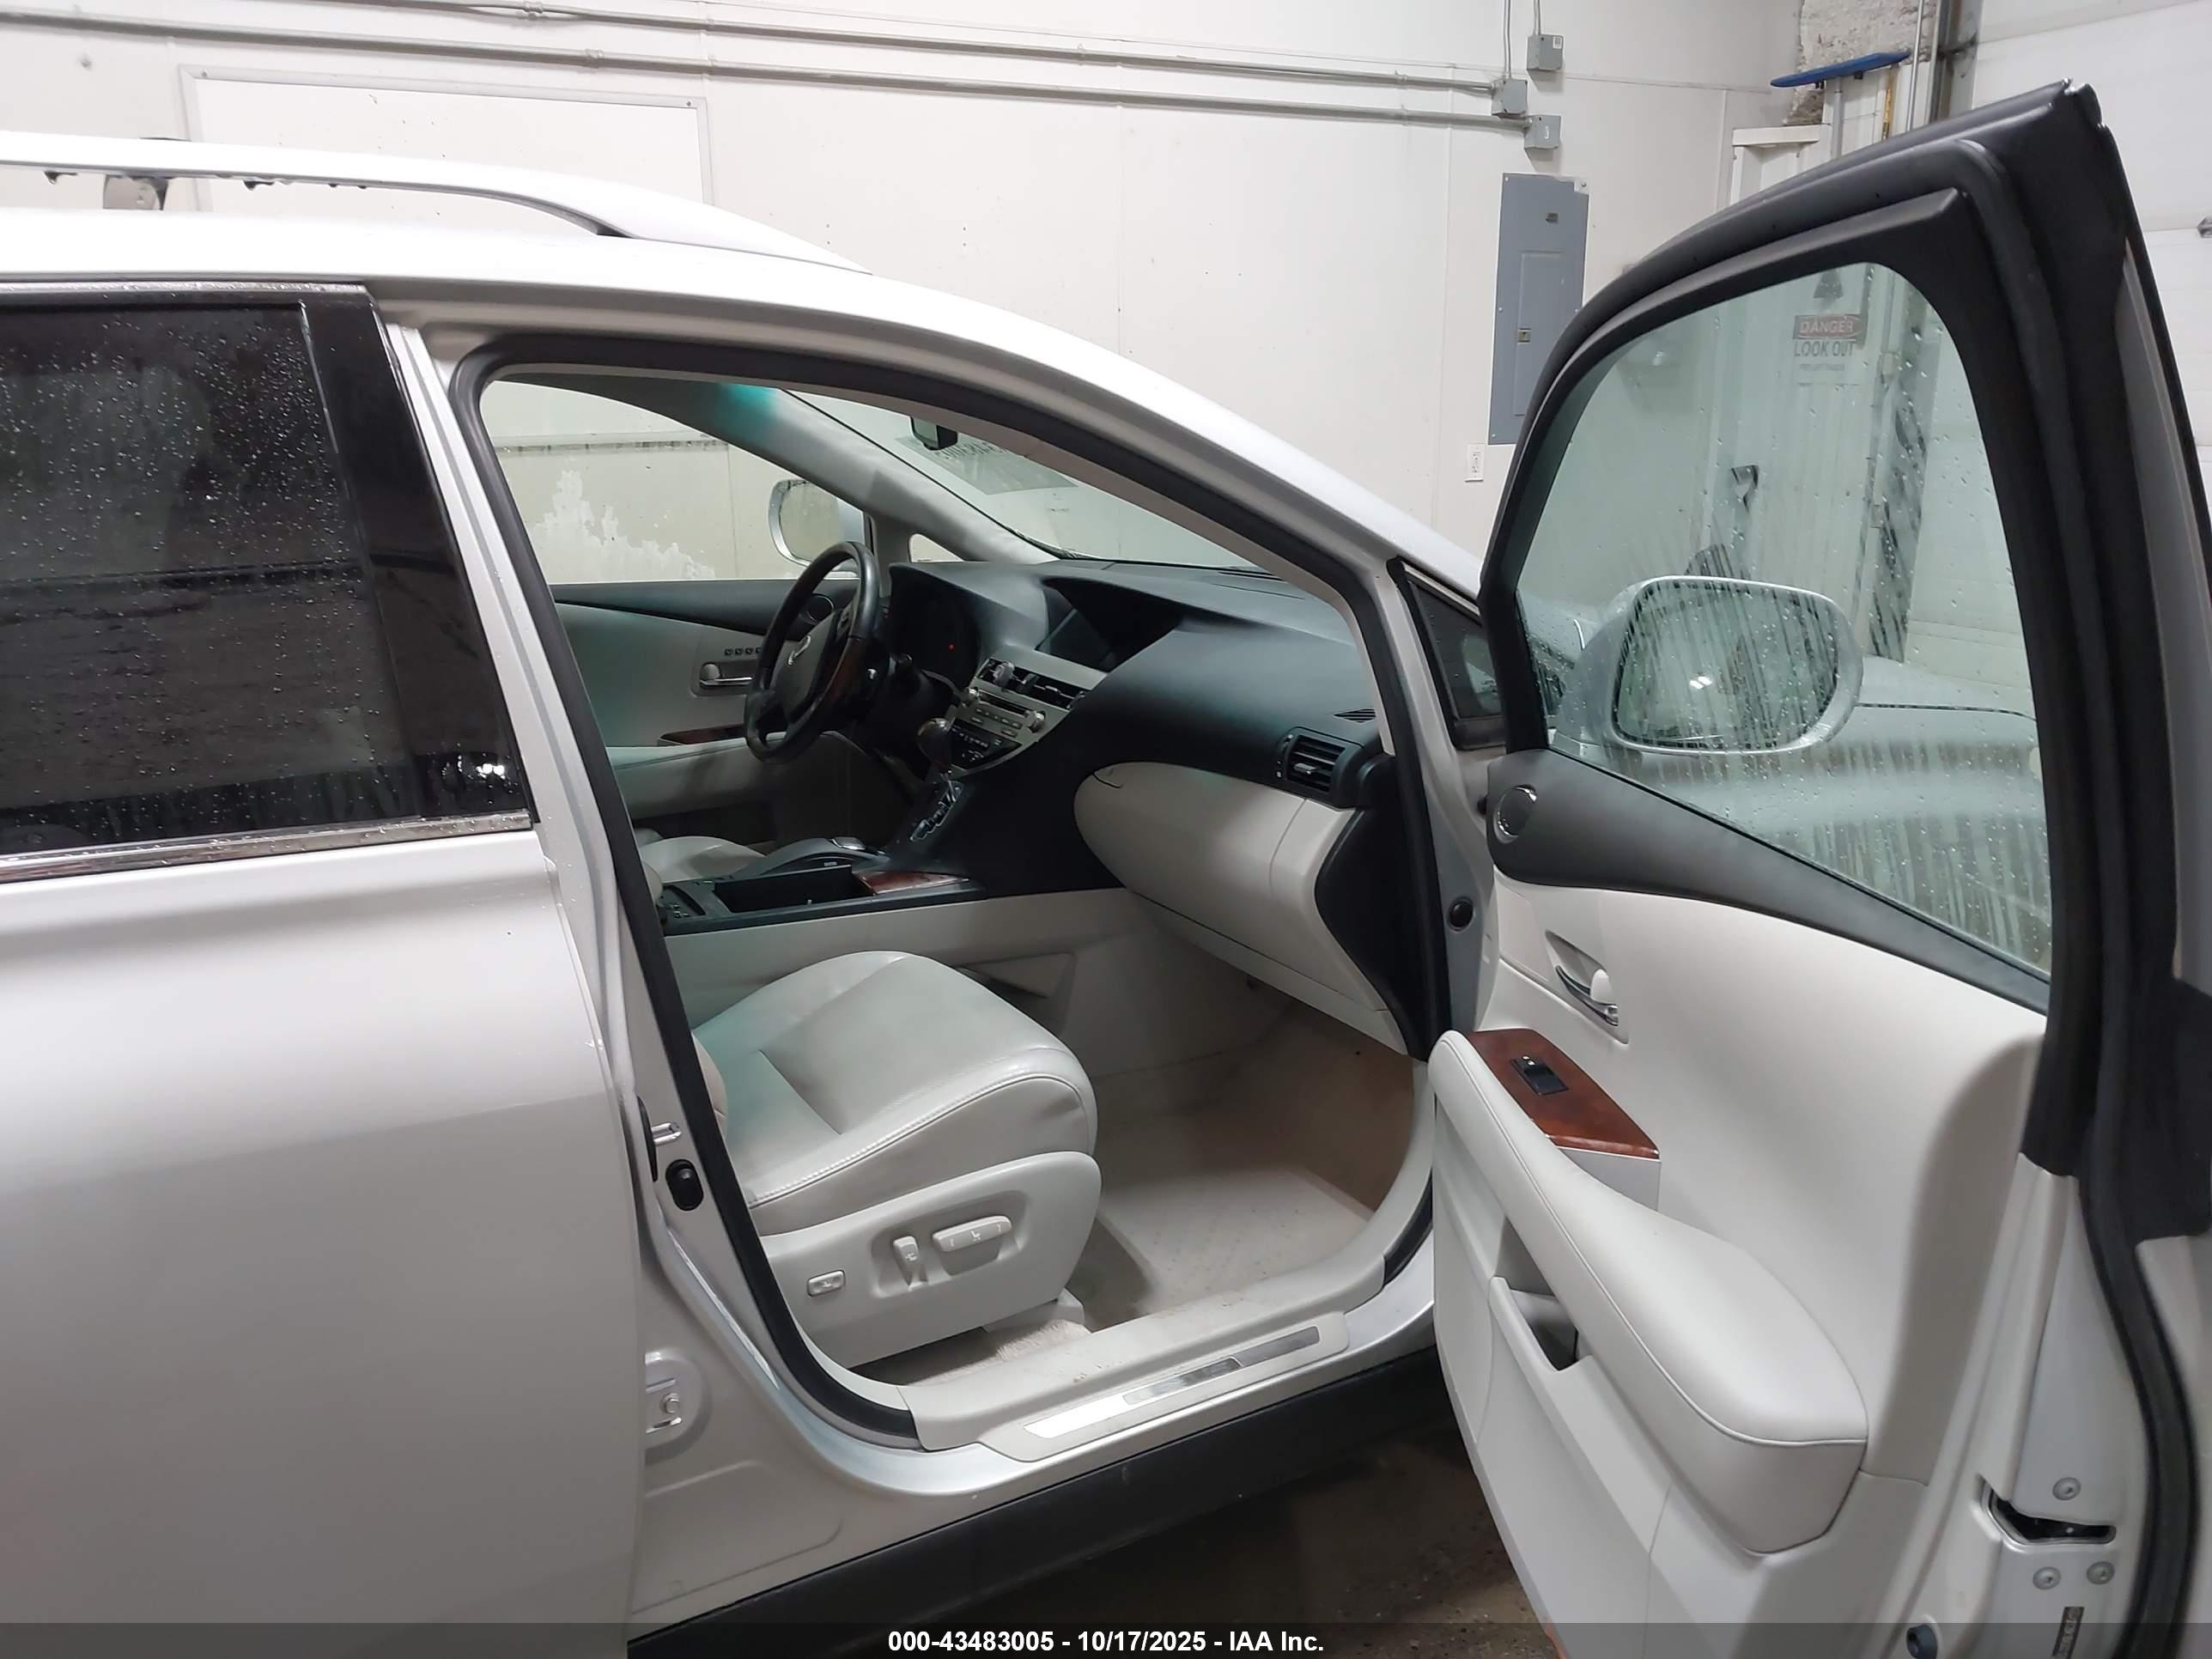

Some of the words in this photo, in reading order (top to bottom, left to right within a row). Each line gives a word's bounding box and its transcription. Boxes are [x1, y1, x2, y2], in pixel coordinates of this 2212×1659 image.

[1799, 319, 1854, 333] DANGER
[1794, 341, 1829, 357] LOOK
[1832, 341, 1854, 357] OUT
